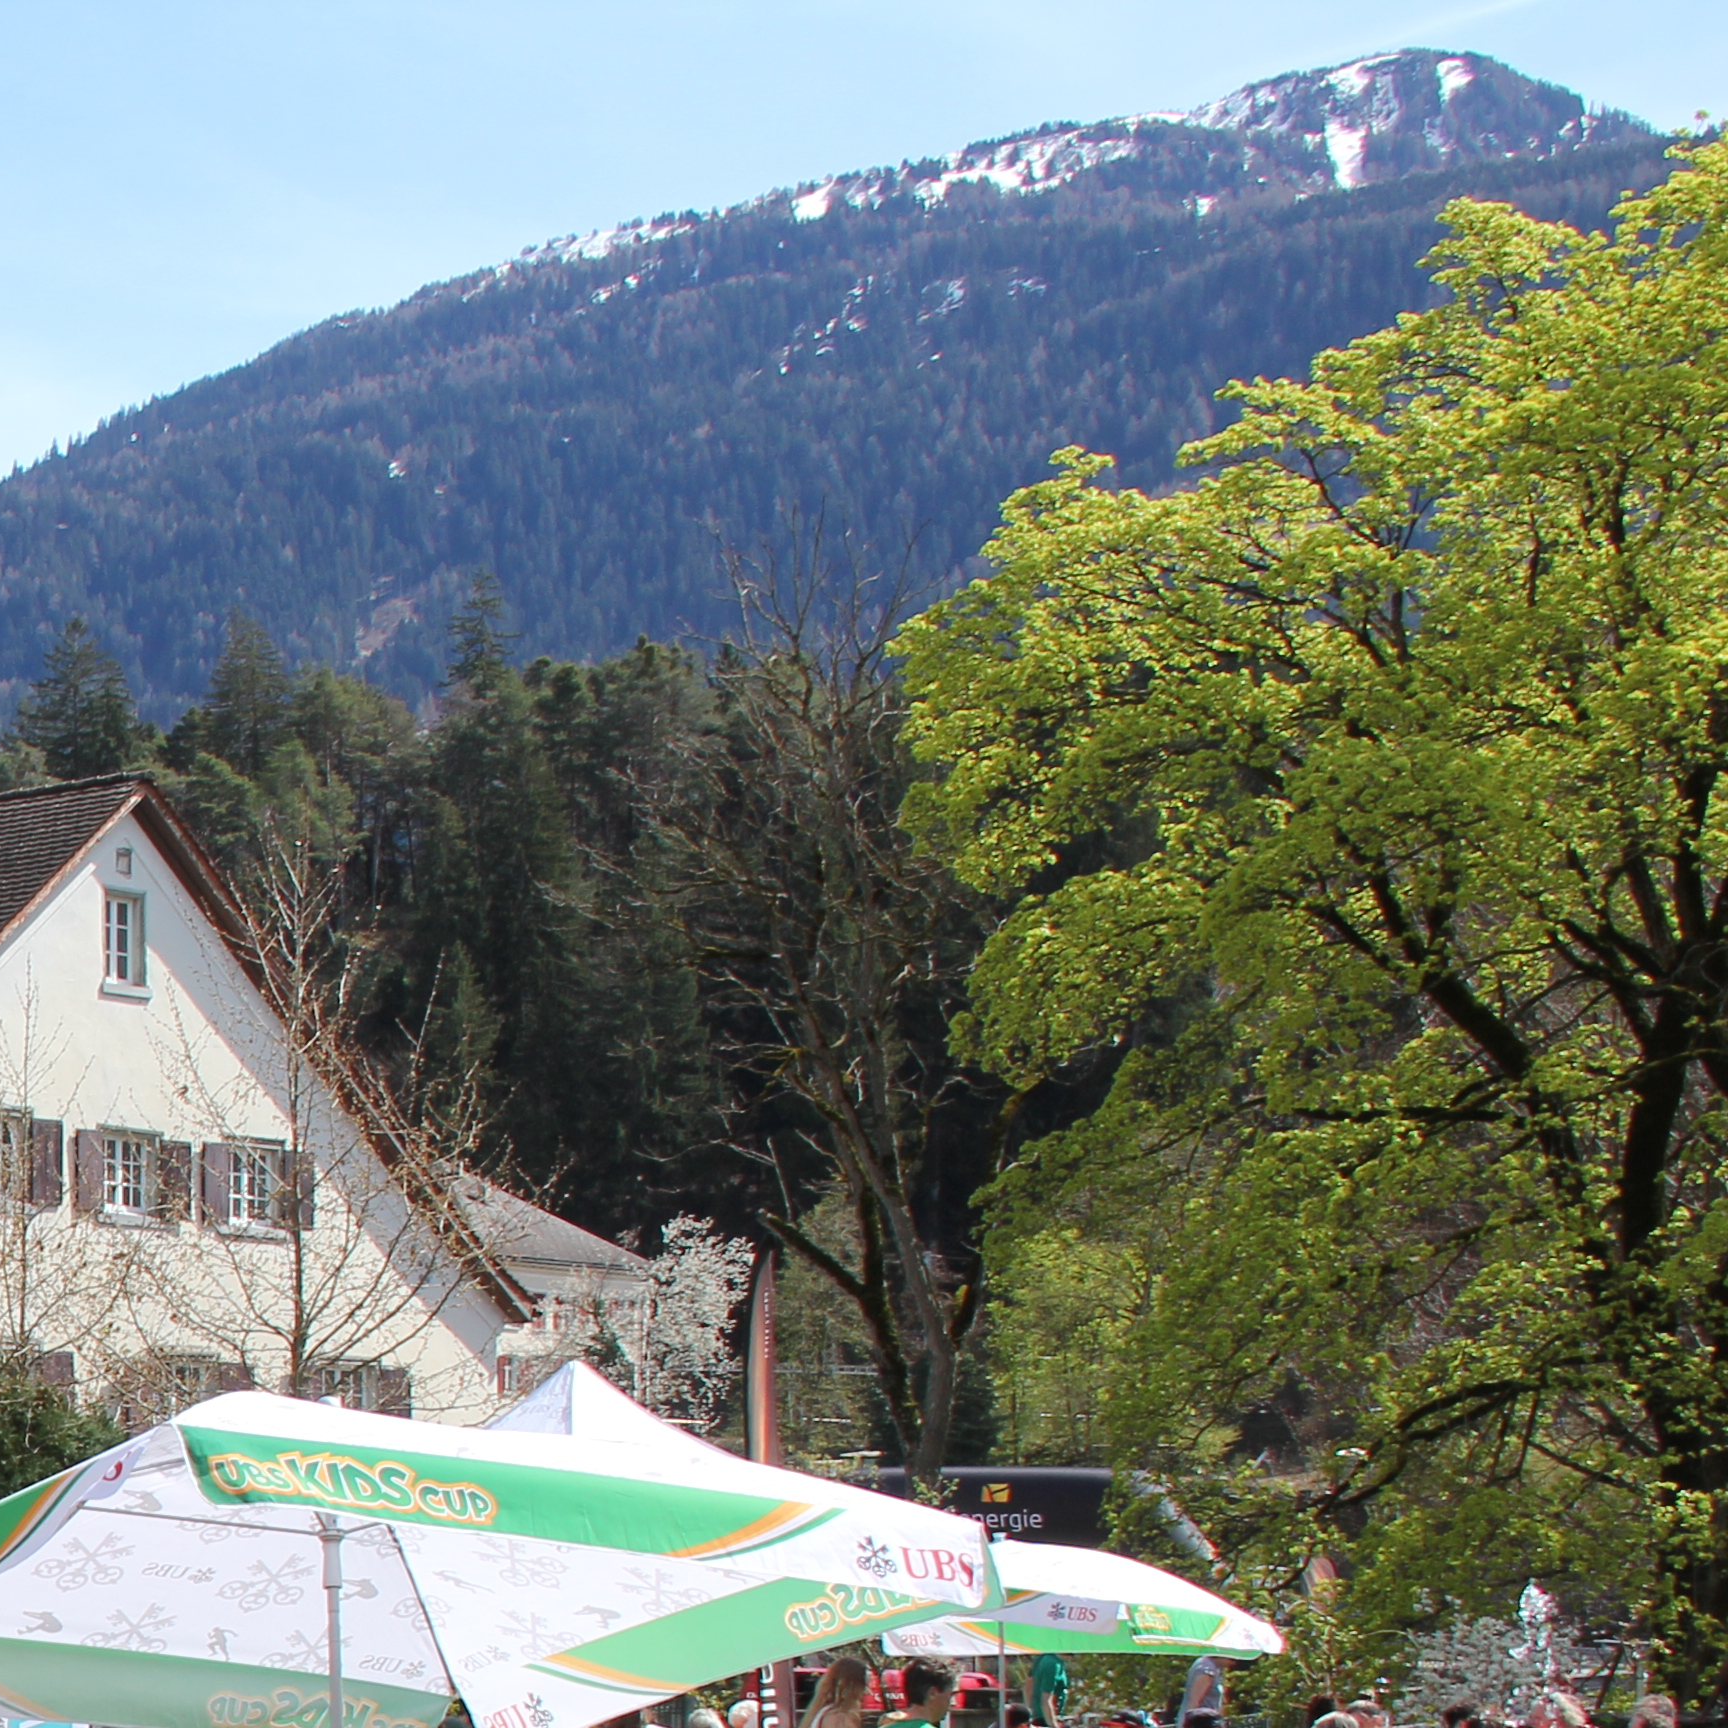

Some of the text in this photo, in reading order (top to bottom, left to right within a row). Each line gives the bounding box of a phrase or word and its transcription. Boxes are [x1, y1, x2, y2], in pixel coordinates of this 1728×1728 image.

[212, 1455, 493, 1521] UBS KIDS CUP
[898, 1546, 975, 1588] UBS
[1066, 1606, 1098, 1622] UBS
